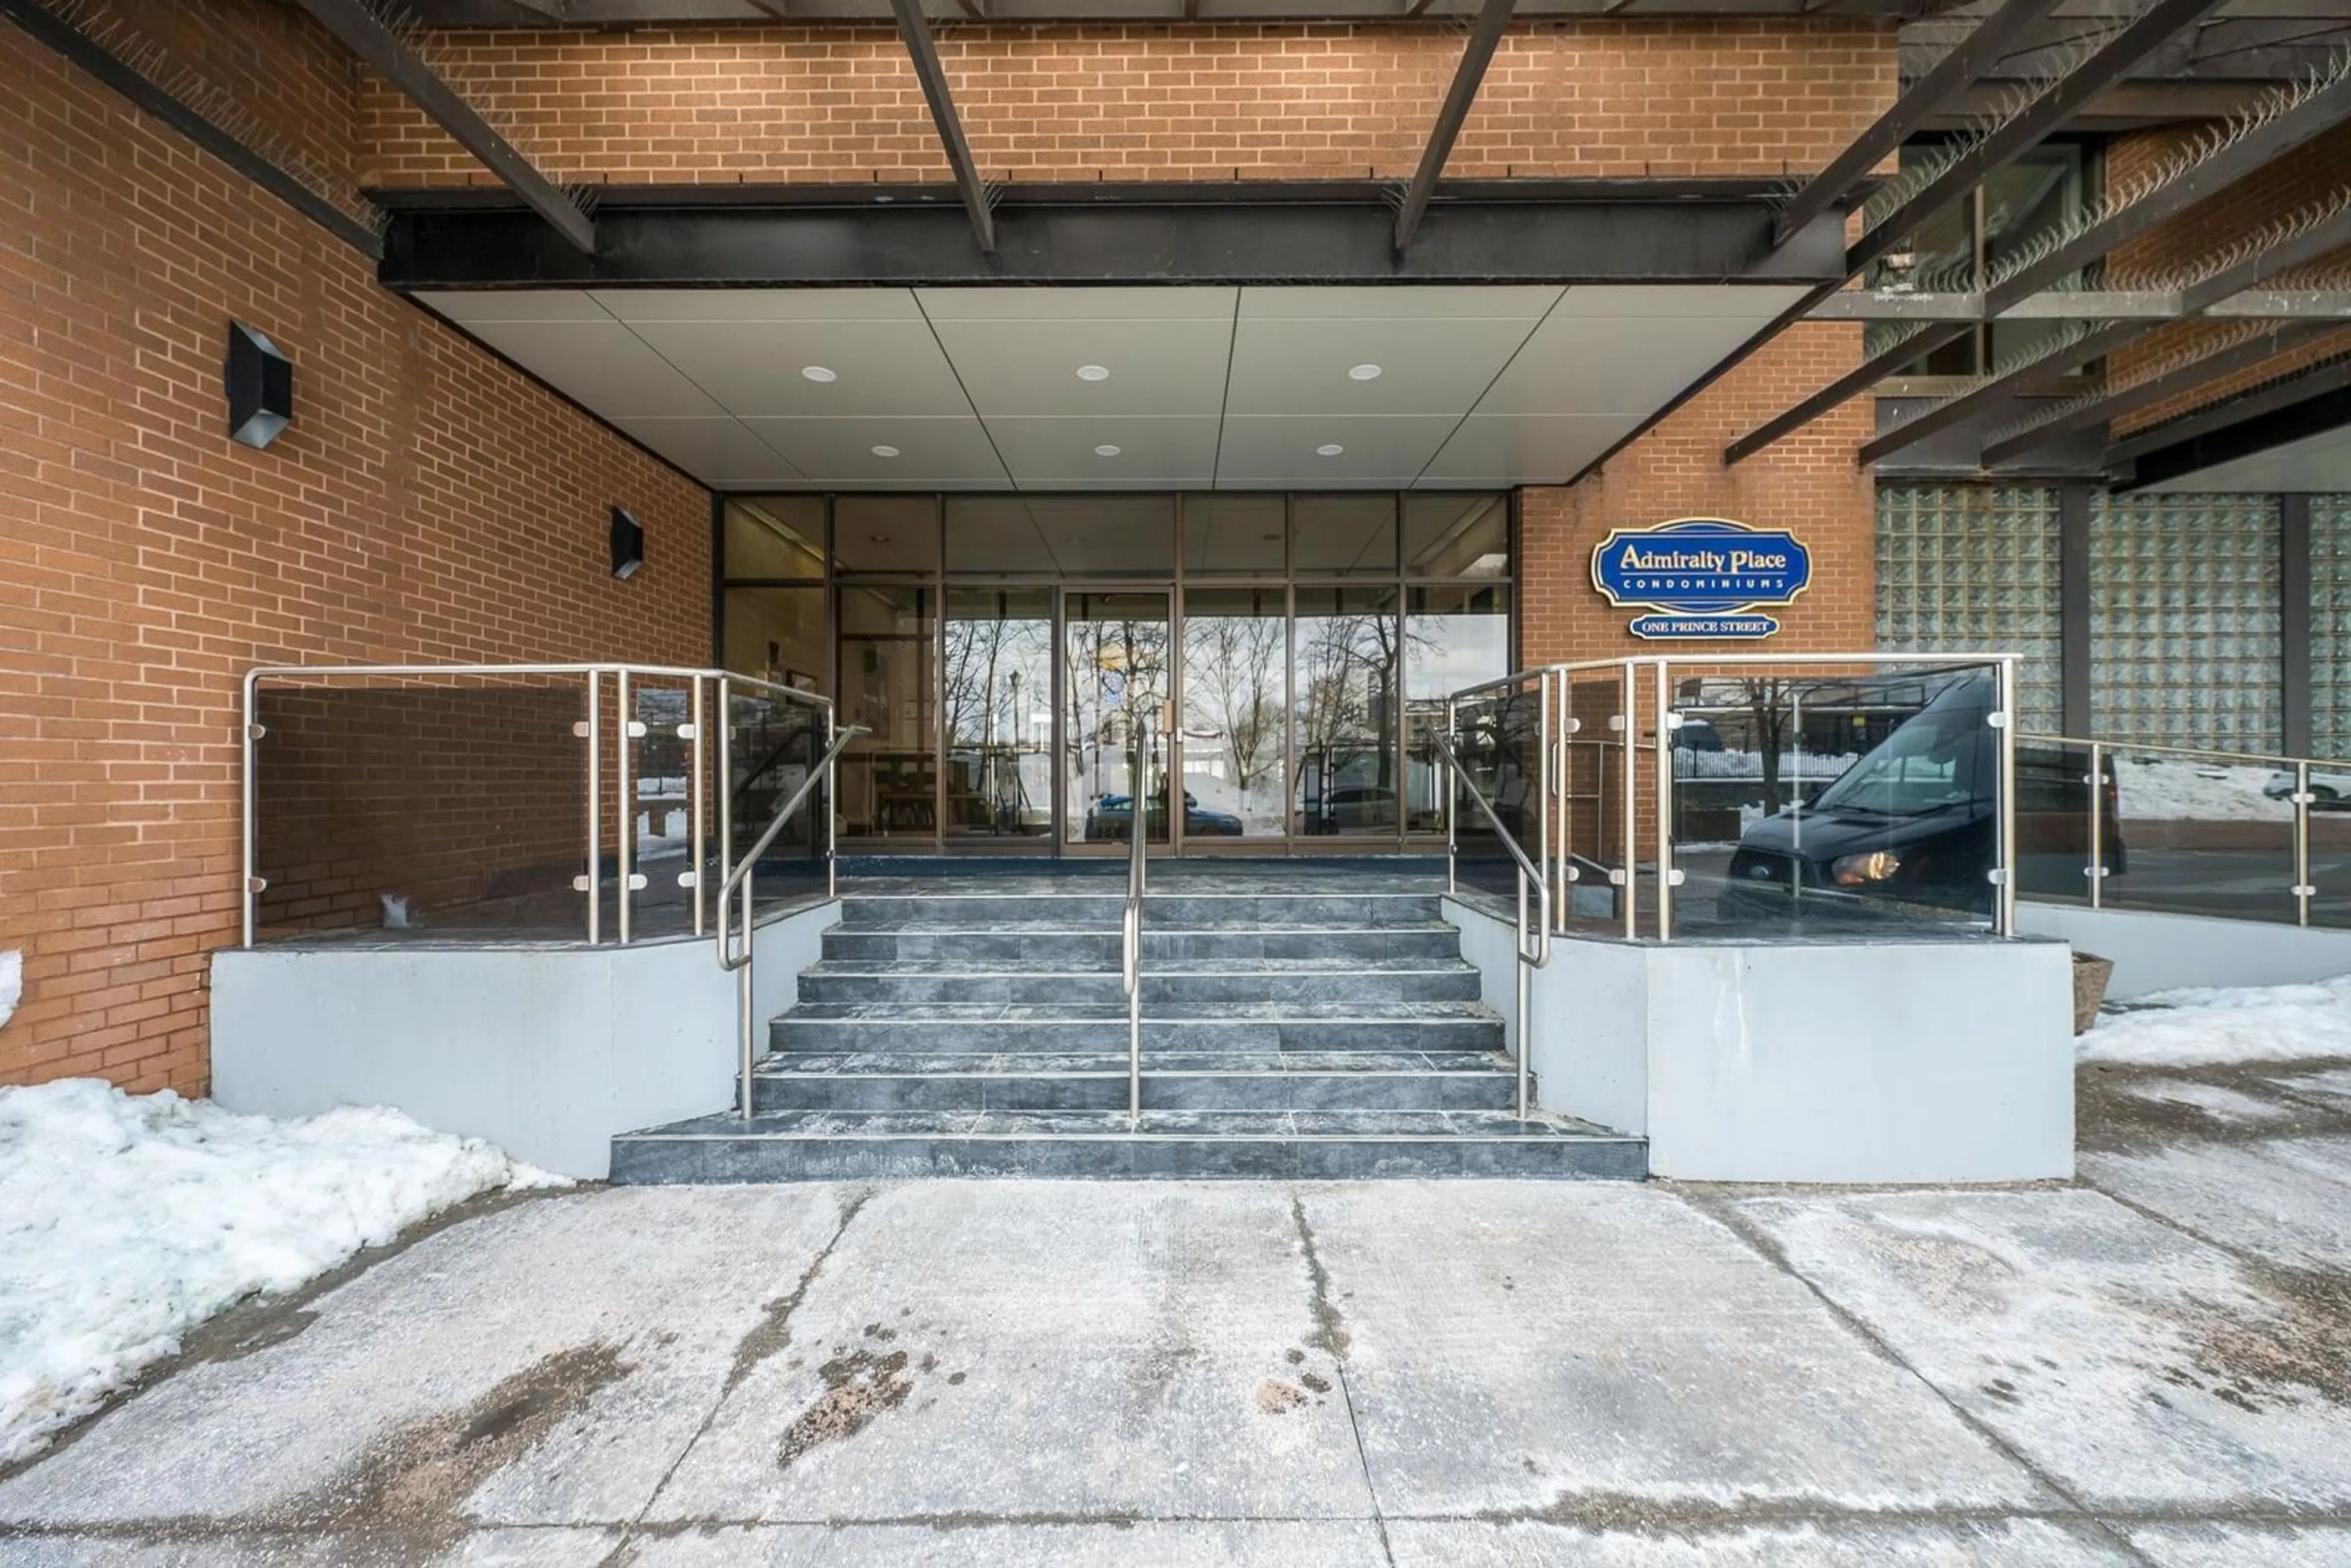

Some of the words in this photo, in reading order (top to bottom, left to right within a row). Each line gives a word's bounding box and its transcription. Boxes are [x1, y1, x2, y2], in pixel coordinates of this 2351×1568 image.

[1621, 544, 1724, 572] Admiralty
[1729, 551, 1787, 574] Place
[1624, 579, 1783, 588] CONDOMINIUMS
[1642, 621, 1668, 632] ONE
[1672, 621, 1717, 632] PRINCE
[1720, 621, 1769, 632] STREET
